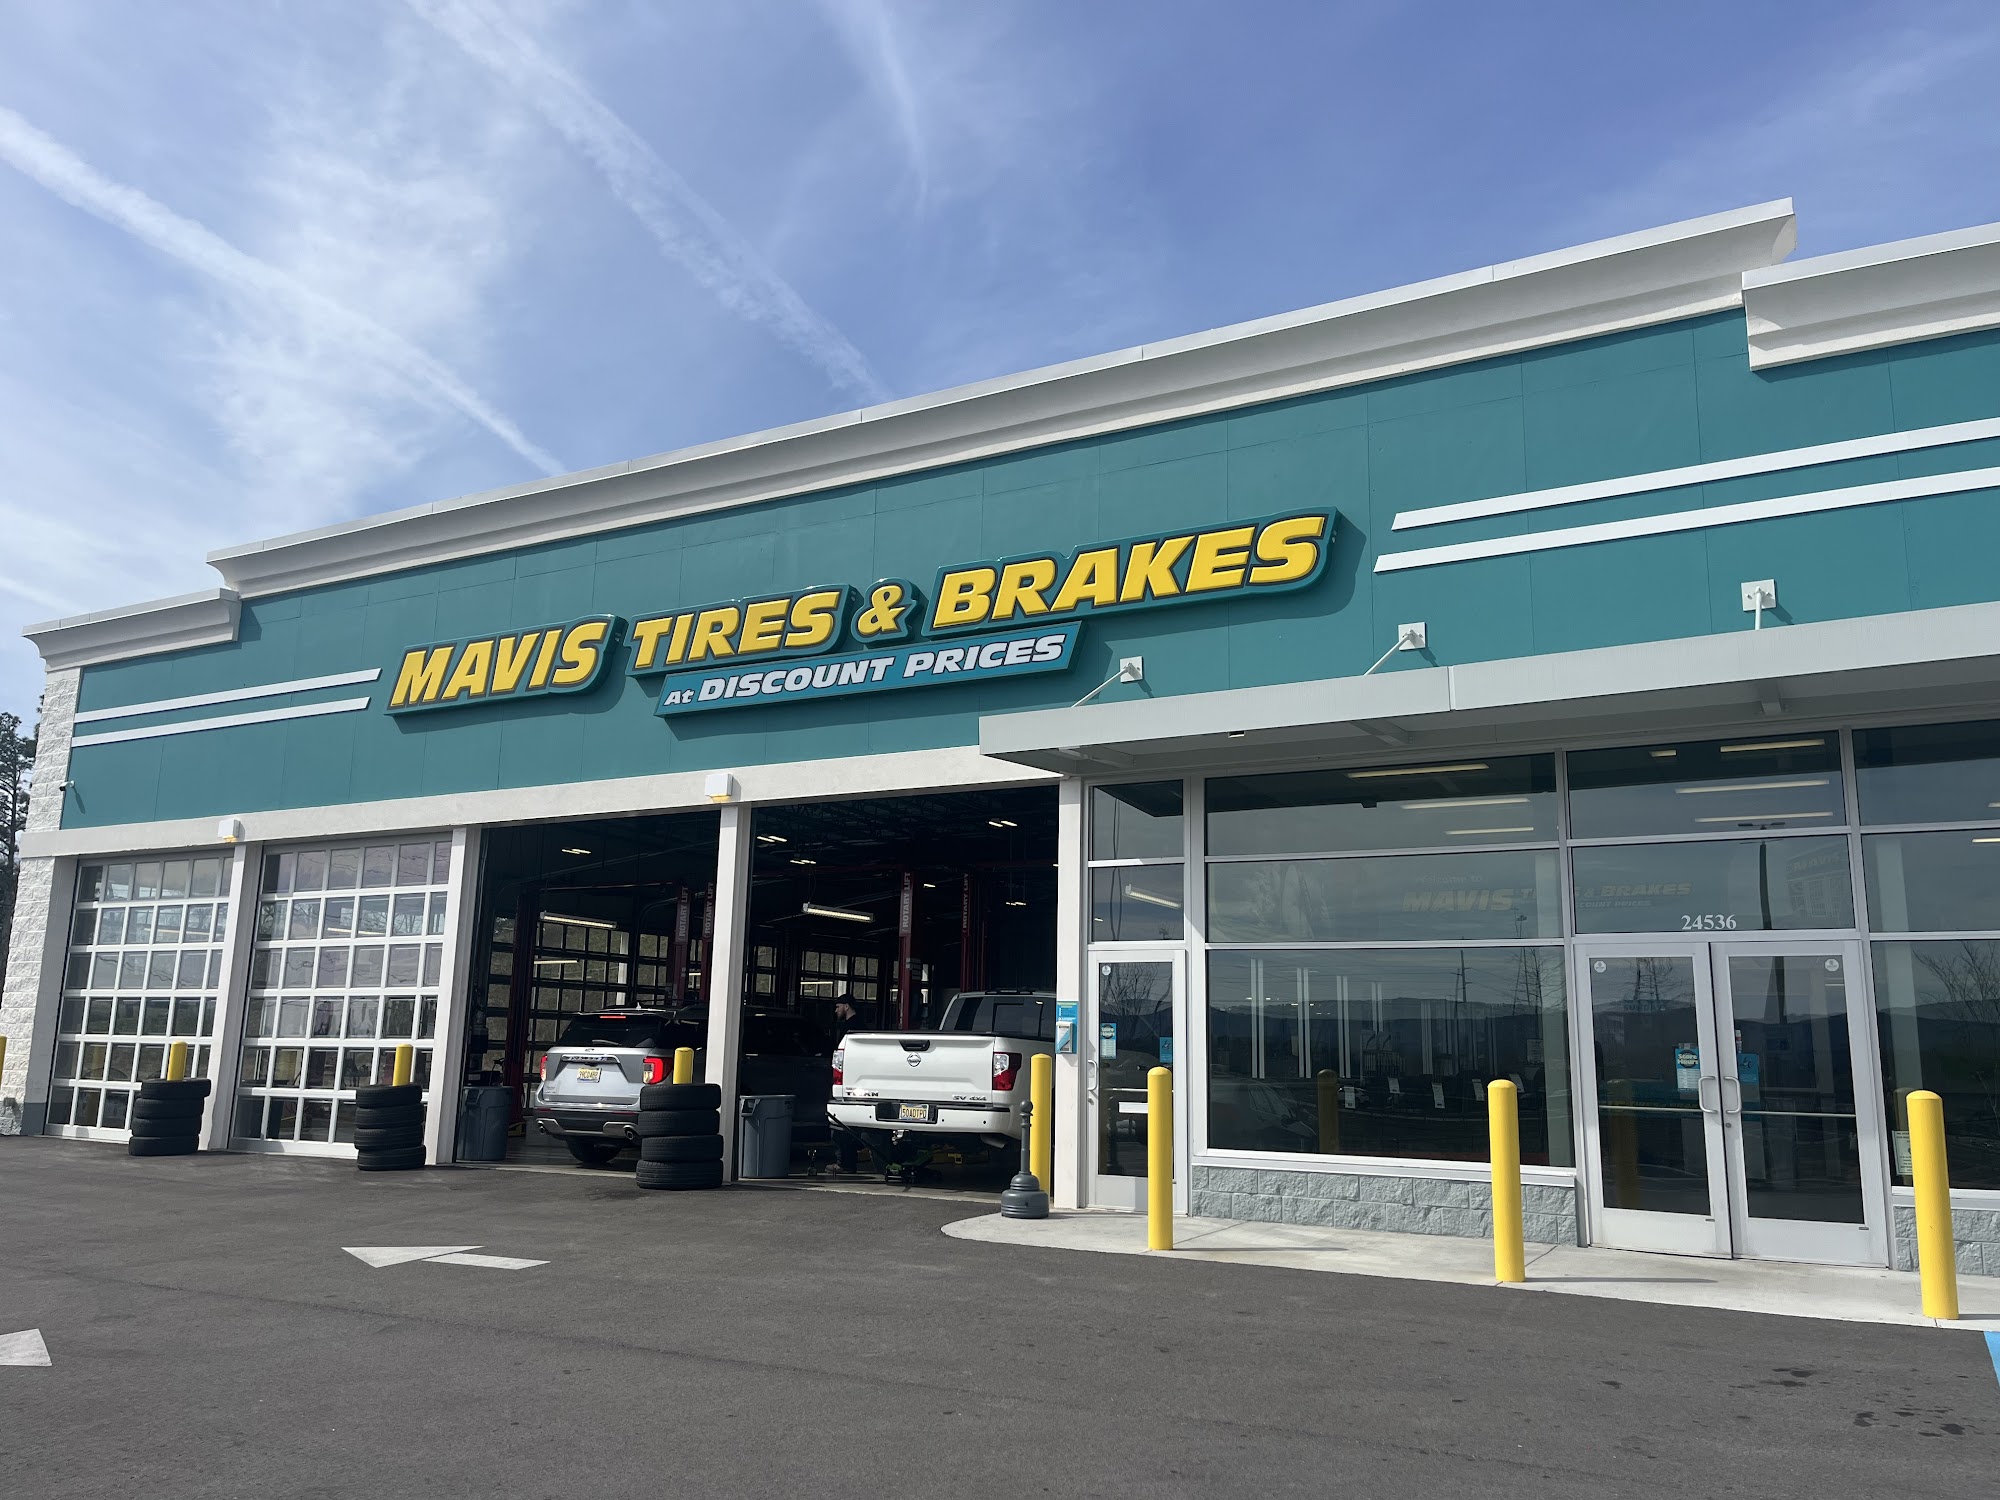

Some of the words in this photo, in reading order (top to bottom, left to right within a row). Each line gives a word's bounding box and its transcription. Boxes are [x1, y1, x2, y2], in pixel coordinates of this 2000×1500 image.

[389, 621, 609, 707] MAVIS
[631, 590, 842, 669] TIRES
[856, 583, 906, 636] &
[932, 516, 1325, 628] BRAKES
[662, 687, 697, 707] At
[697, 657, 894, 700] DISCOUNT
[902, 634, 1067, 677] PRICES
[681, 886, 689, 903] LIFT
[1402, 887, 1514, 911] MAVIS
[1600, 882, 1692, 897] BRAKES
[678, 905, 688, 936] ROTARY
[704, 902, 713, 933] ROTARY
[902, 893, 910, 928] ROTARY
[1681, 914, 1737, 931] 24536
